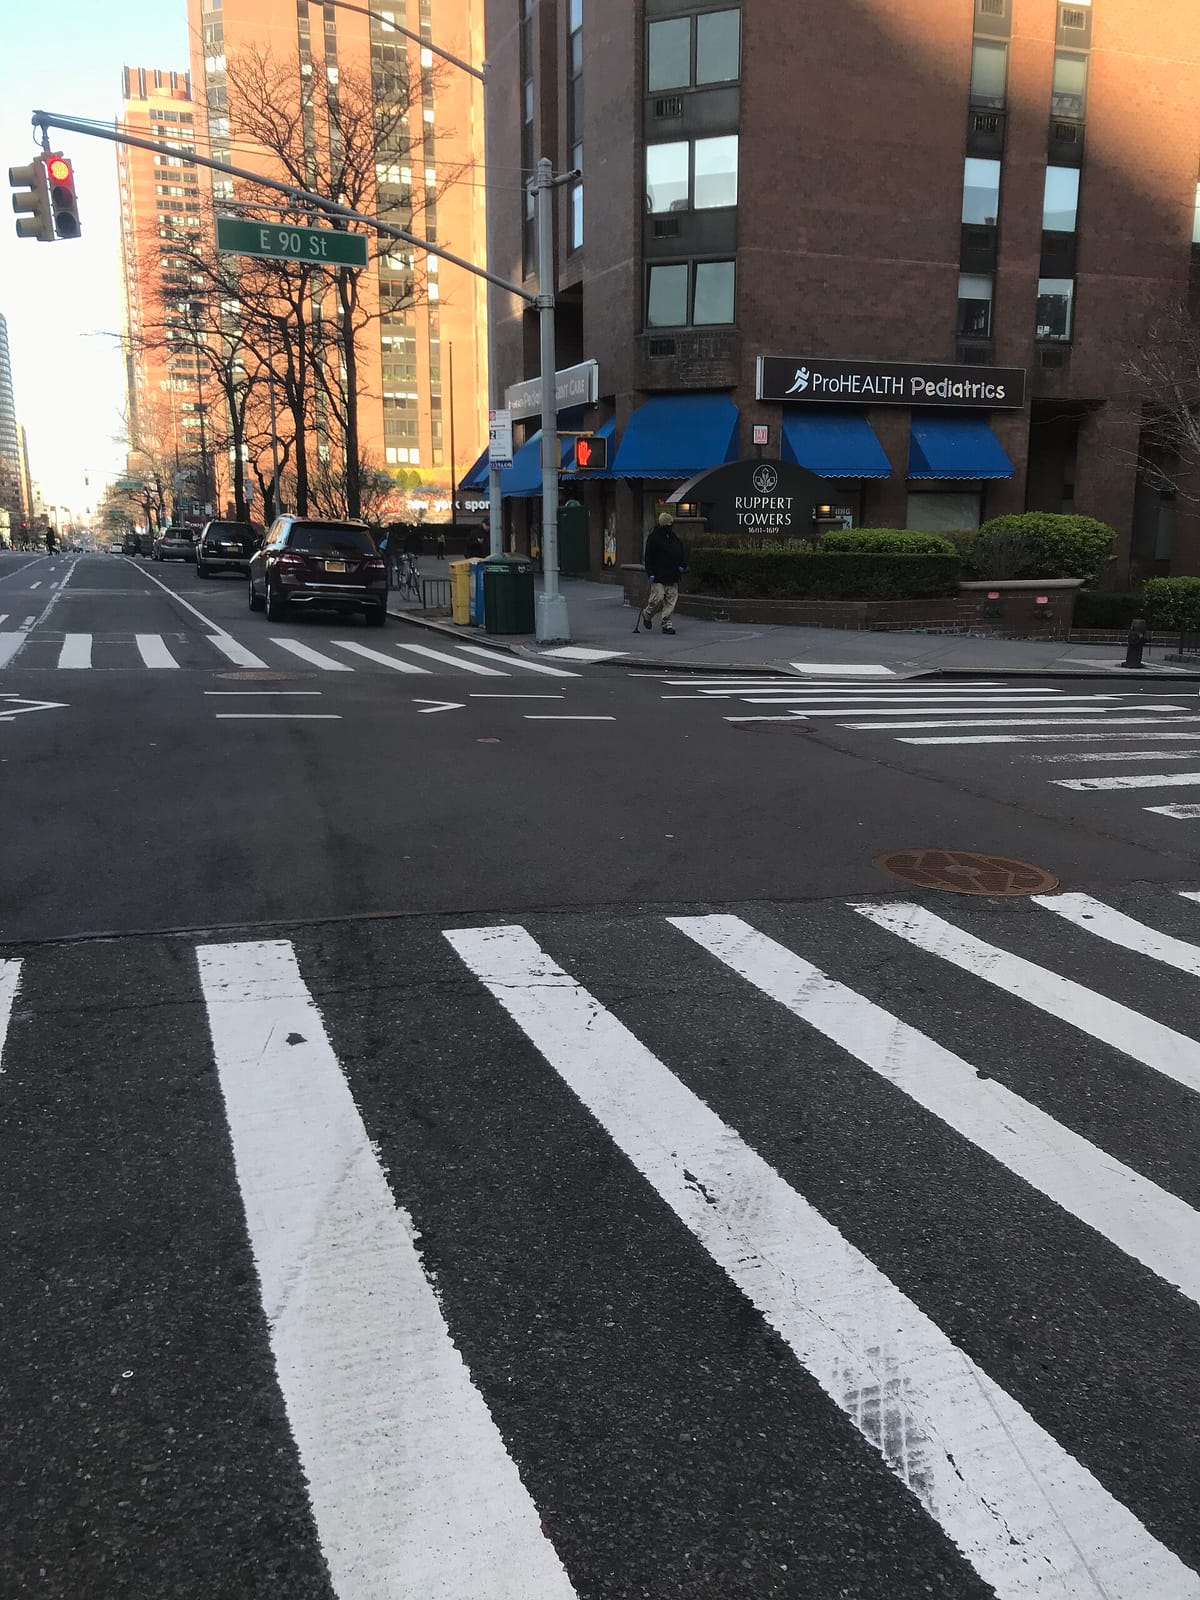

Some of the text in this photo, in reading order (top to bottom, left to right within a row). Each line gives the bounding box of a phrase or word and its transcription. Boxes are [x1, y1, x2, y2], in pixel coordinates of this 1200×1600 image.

[260, 229, 328, 256] E 90 St
[812, 373, 1006, 399] ProHEALTH Pediatrics
[735, 496, 794, 509] RUPPERT
[736, 512, 792, 525] TOWERS
